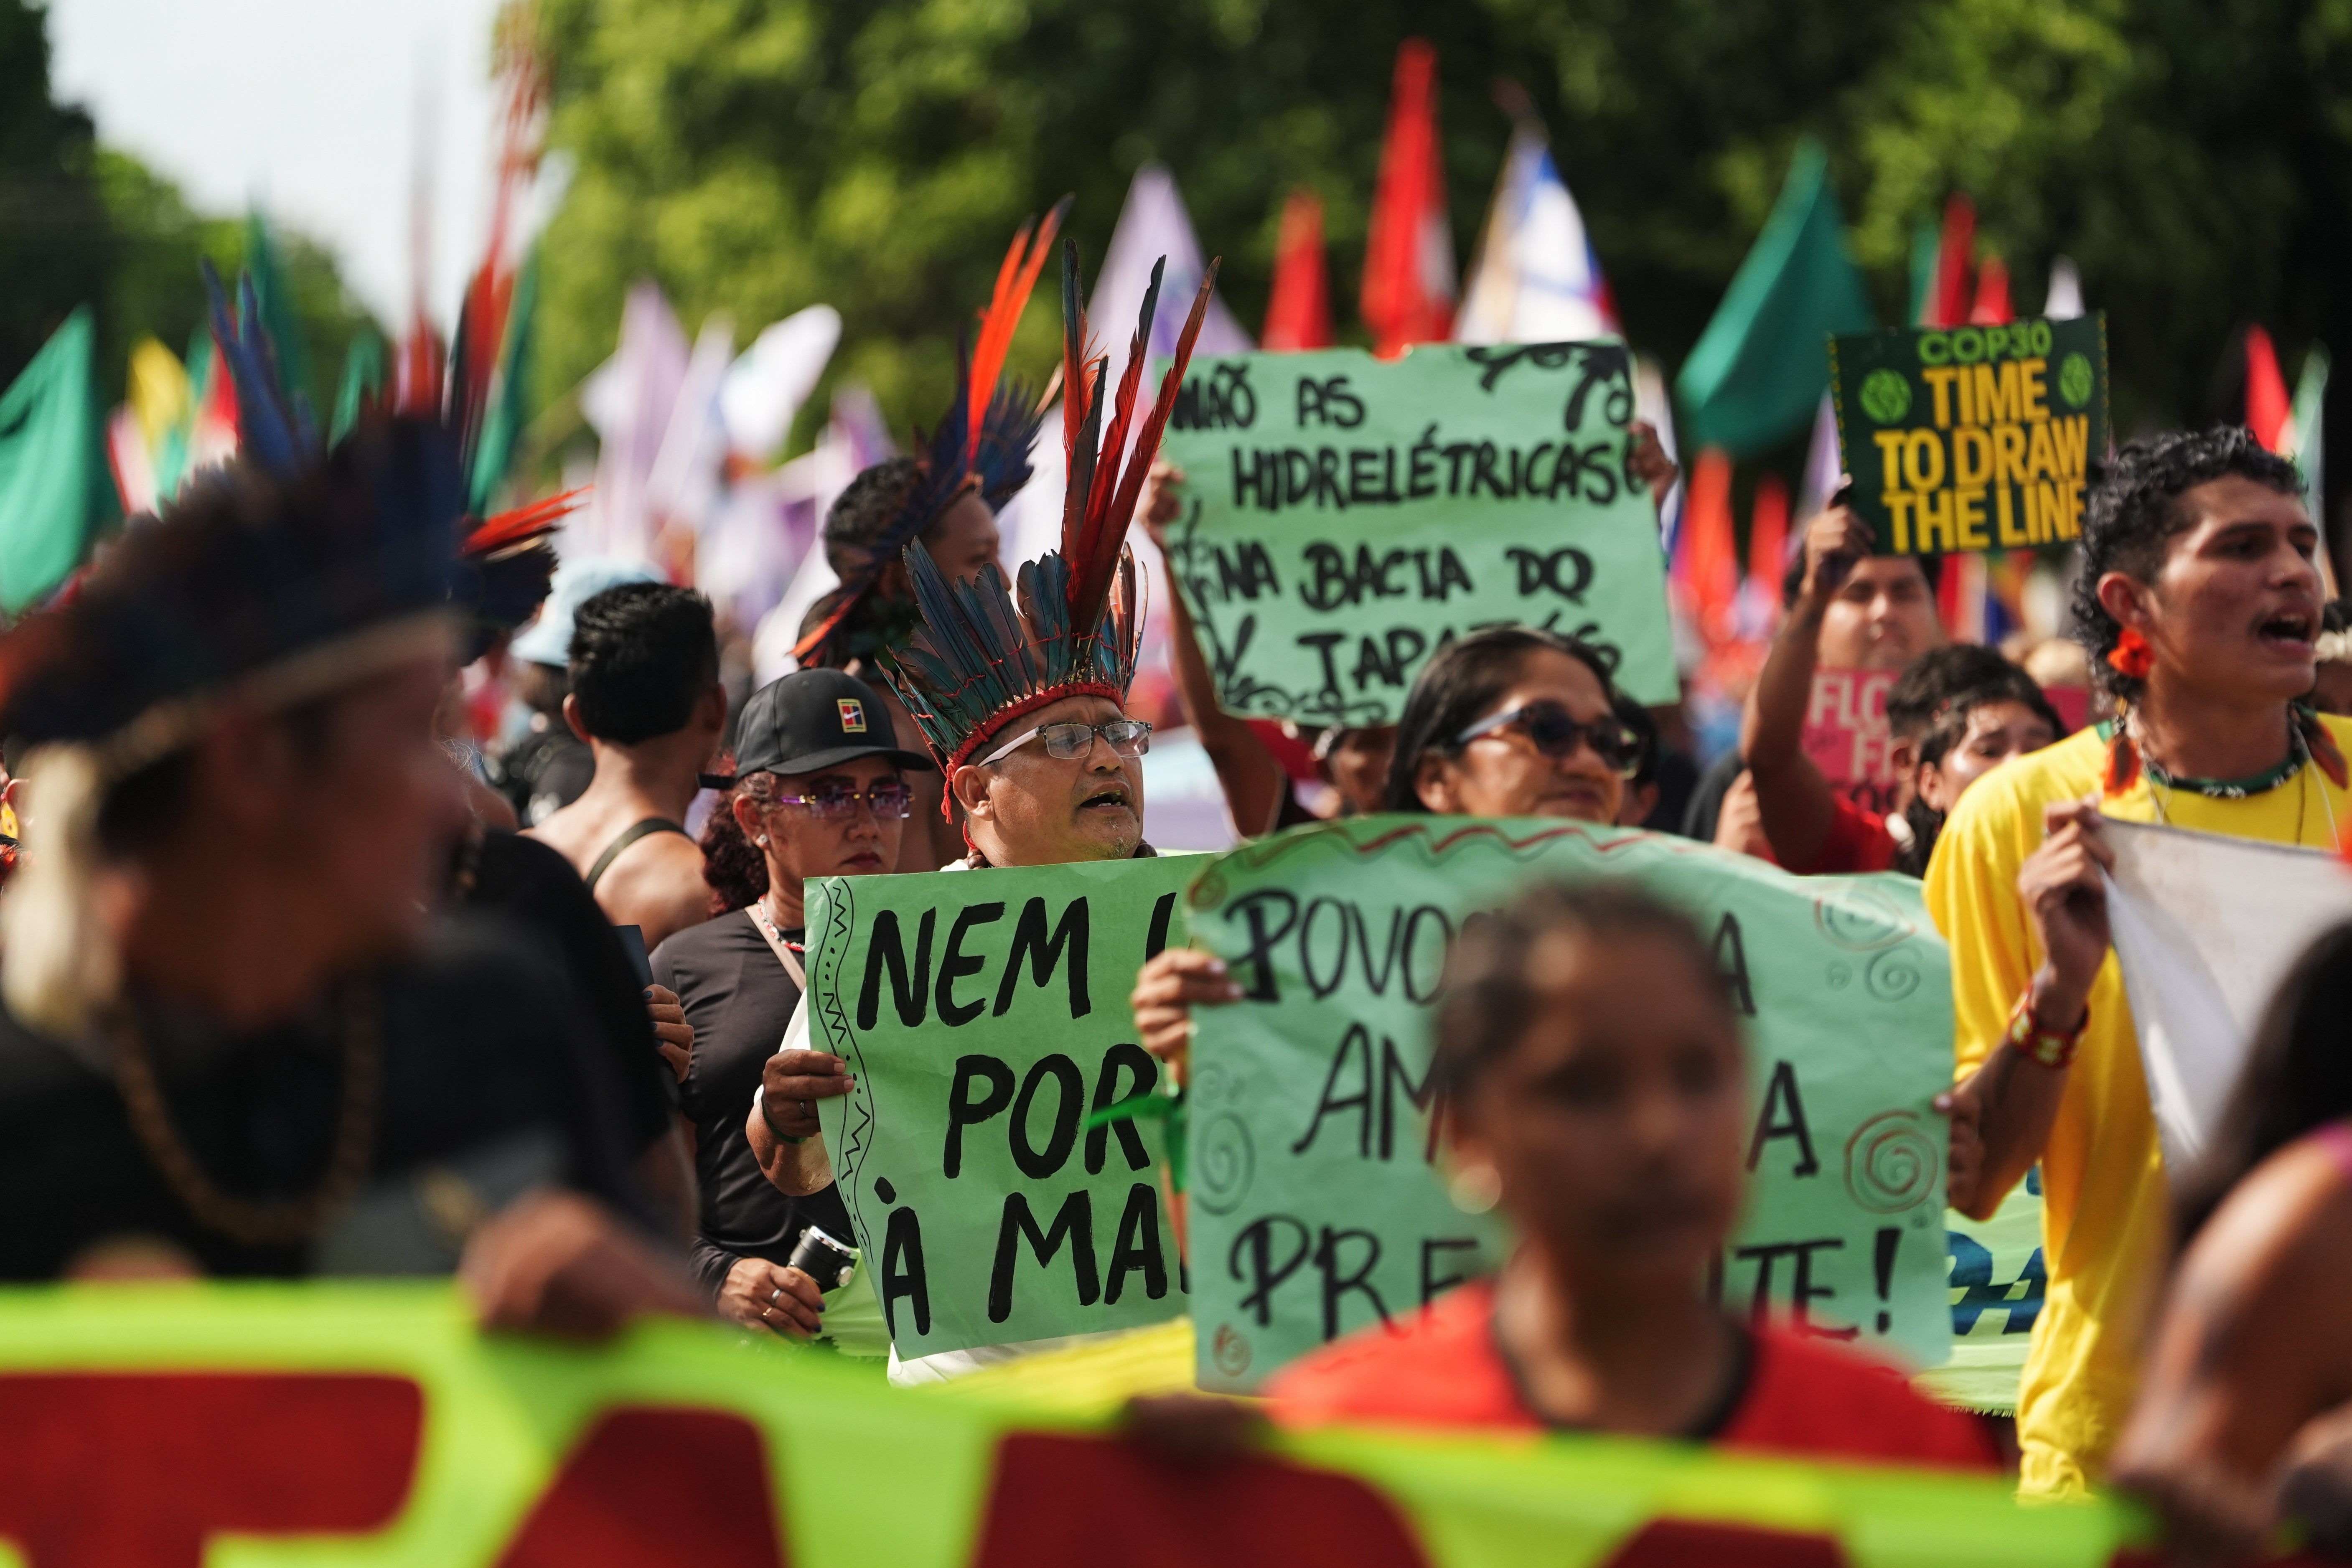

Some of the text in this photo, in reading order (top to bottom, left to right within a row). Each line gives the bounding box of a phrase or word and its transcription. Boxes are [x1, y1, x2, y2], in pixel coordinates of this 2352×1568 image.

[1917, 320, 2053, 365] COP30
[1298, 377, 1364, 428] AS
[1922, 358, 2050, 429] TIME
[1233, 424, 1619, 510] HIDRELÉTRICAS
[1873, 414, 2089, 493] TO DRAW
[1881, 479, 2087, 554] THE LINE
[1214, 540, 1594, 611] NA BACIA DO
[856, 895, 1091, 1031] NEM
[1223, 888, 1454, 1009] POVO
[943, 1043, 1159, 1179] POR
[874, 1176, 1191, 1341] À MA
